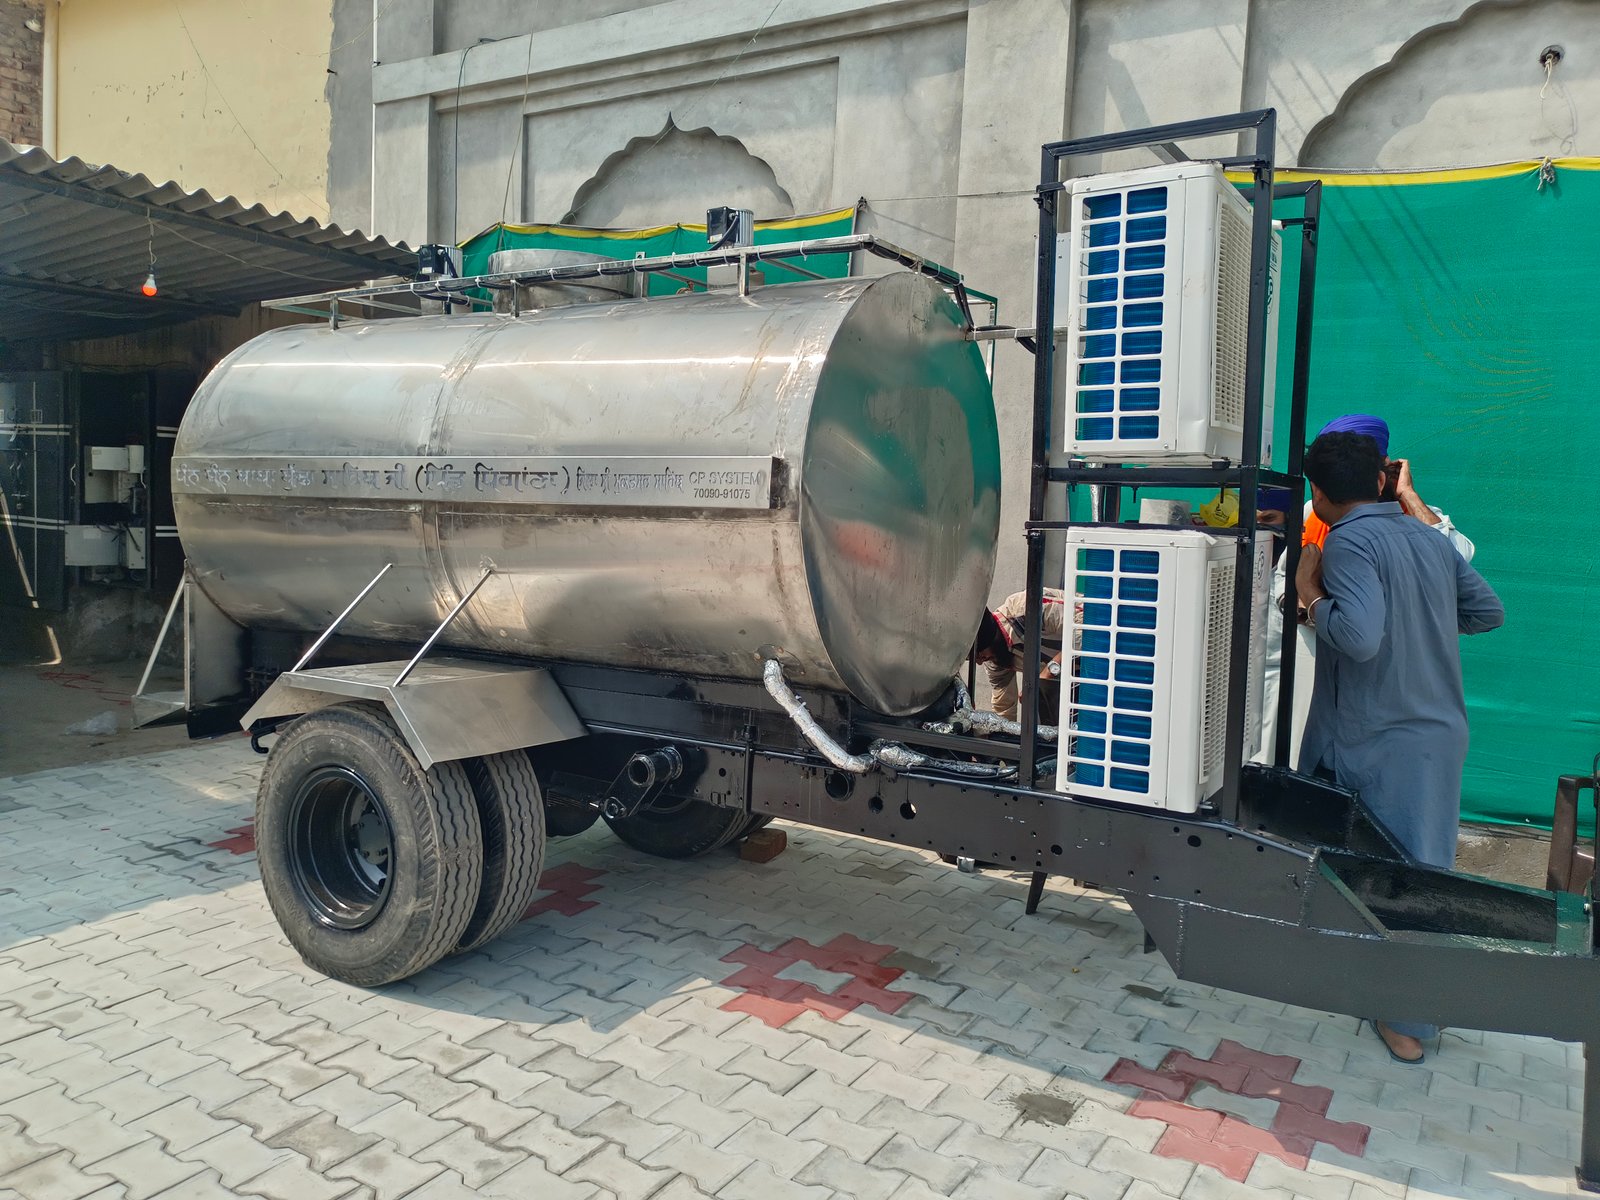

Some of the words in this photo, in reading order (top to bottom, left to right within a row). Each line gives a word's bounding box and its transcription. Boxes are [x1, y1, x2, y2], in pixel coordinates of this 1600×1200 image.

[384, 462, 410, 490] ਜੀ
[689, 471, 706, 485] CP
[709, 471, 761, 486] SYSTEM
[693, 488, 751, 499] 70090-91075
